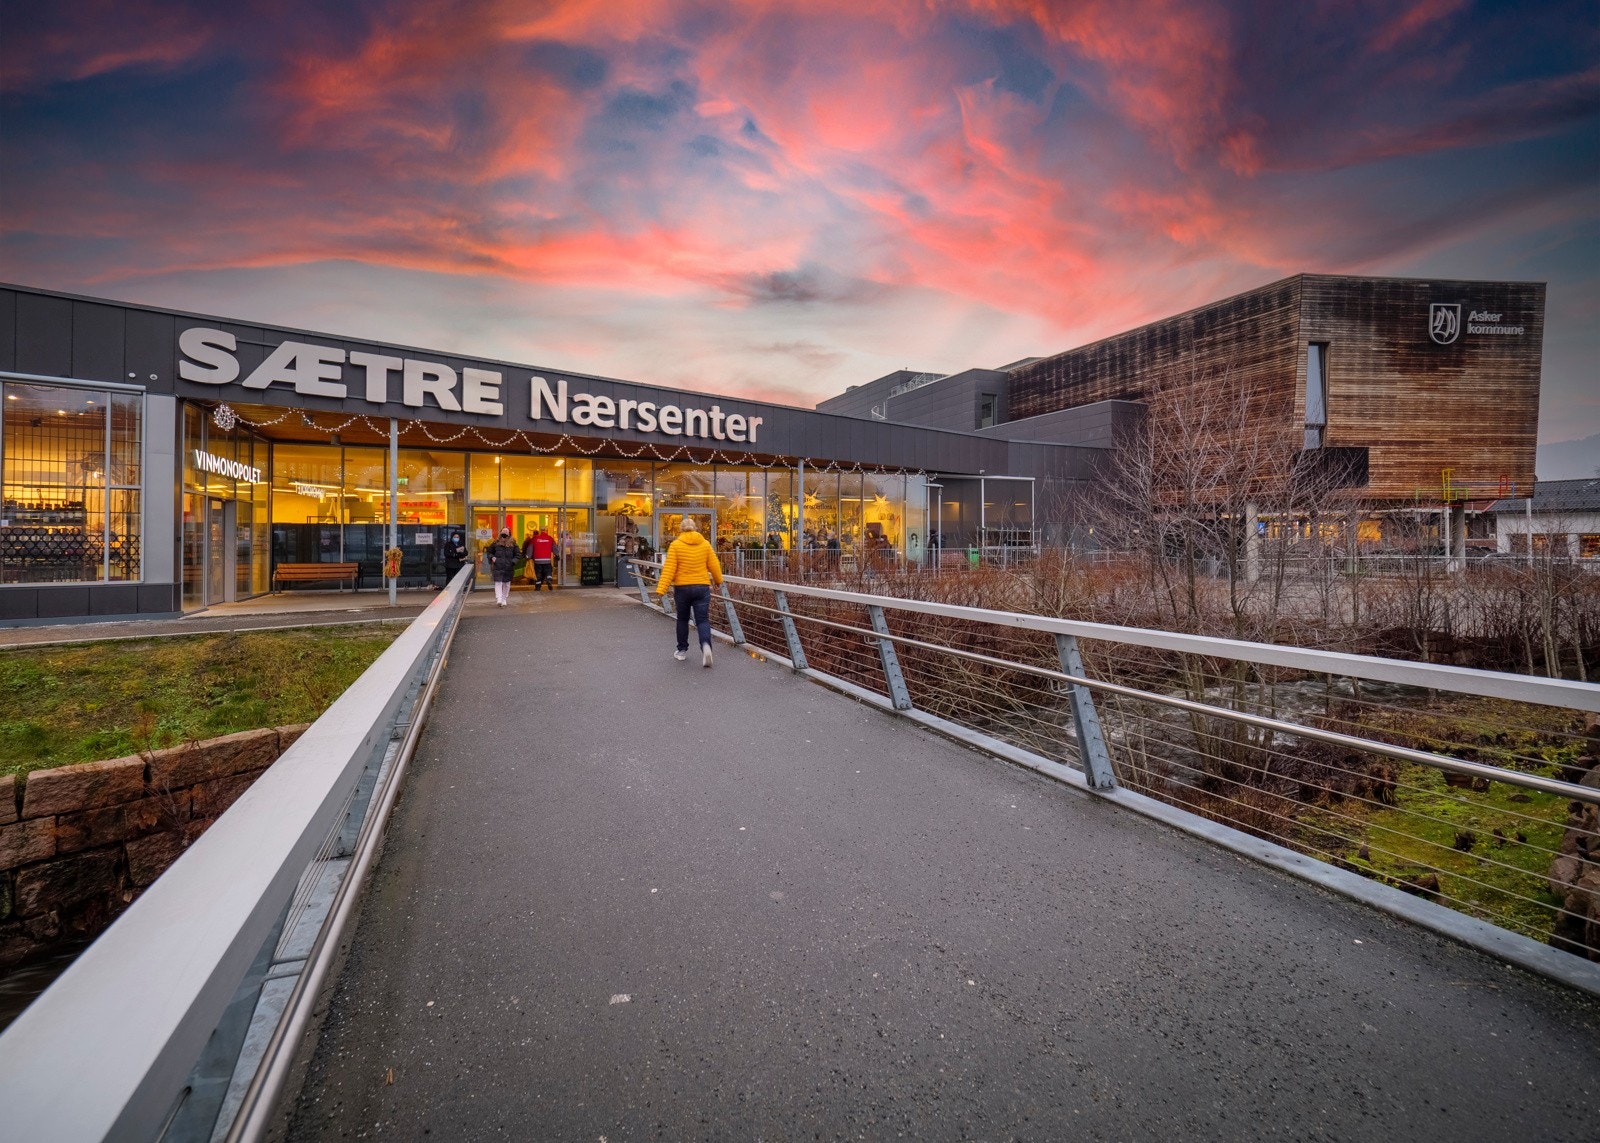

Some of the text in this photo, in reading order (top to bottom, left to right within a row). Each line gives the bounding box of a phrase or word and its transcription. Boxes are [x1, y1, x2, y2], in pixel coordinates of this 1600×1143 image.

[1468, 310, 1503, 322] Asker
[1467, 323, 1525, 335] kommune
[178, 327, 763, 443] SÆTRE Nærsenter
[194, 449, 262, 484] VINMONOPOLET
